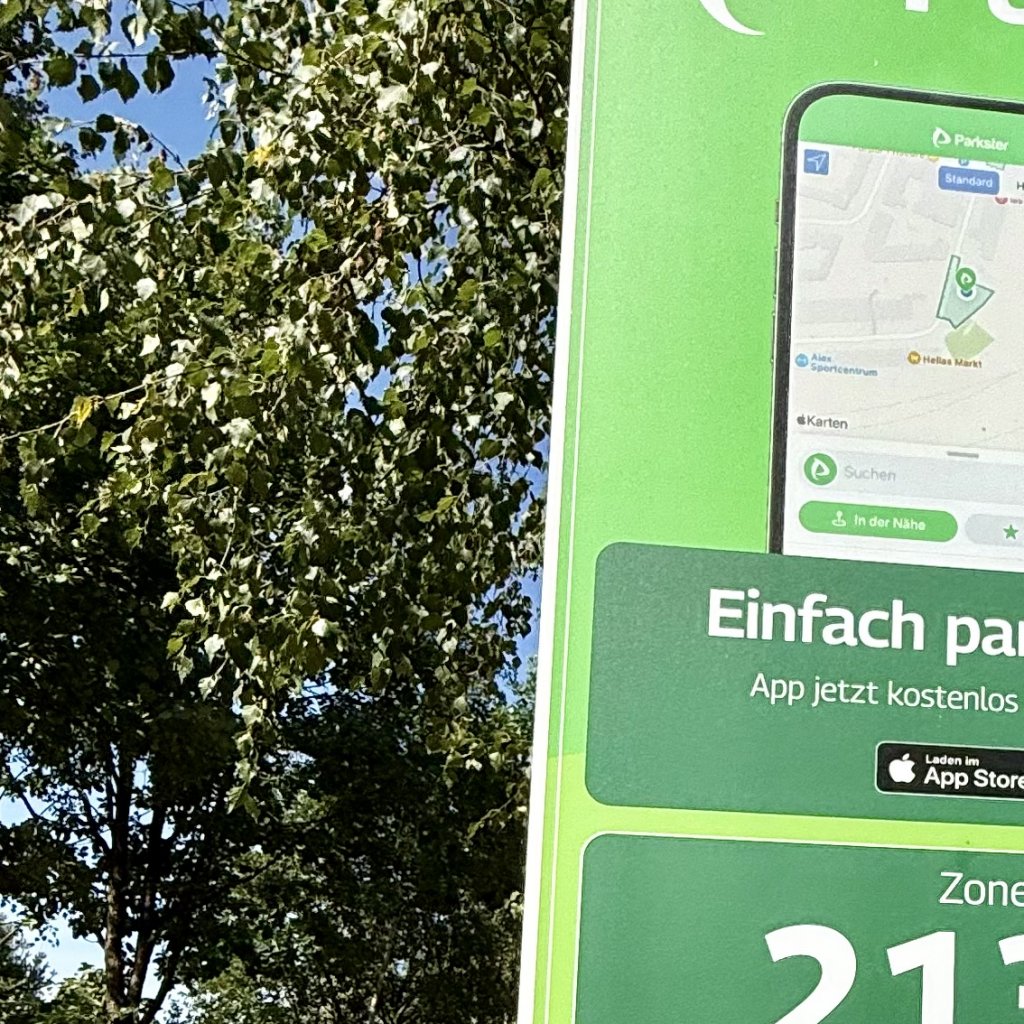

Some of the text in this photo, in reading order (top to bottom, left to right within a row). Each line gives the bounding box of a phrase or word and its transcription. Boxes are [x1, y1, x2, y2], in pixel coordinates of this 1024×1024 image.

[954, 133, 1009, 151] Parkster
[945, 173, 993, 188] Standard
[811, 363, 878, 377] Sportcentrum
[923, 355, 982, 369] Hellas Markt
[807, 415, 848, 430] Karten
[844, 465, 896, 483] Suchen
[853, 513, 926, 531] In der Nähe
[707, 587, 926, 651] Einfach
[750, 673, 805, 706] App
[811, 675, 879, 708] jetzt
[887, 680, 1018, 714] kostenlos
[925, 754, 980, 767] Laden im
[924, 766, 969, 790] App
